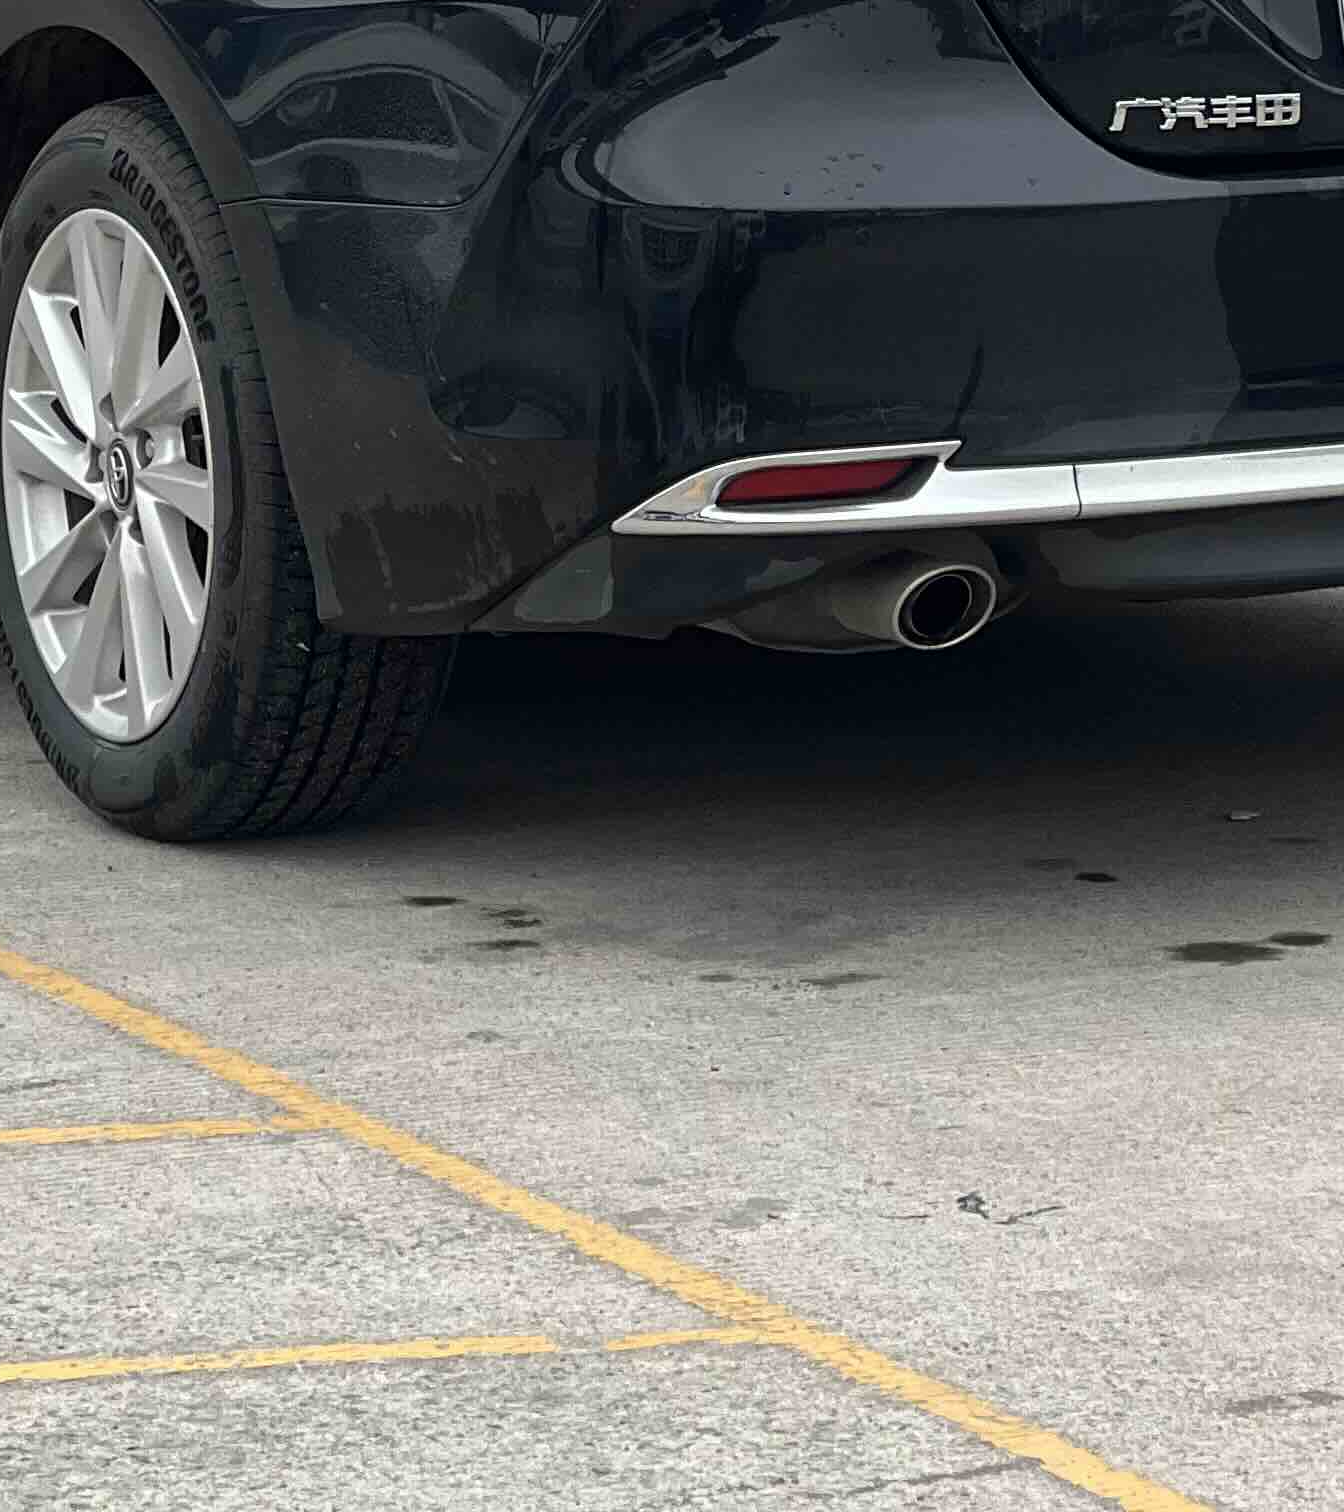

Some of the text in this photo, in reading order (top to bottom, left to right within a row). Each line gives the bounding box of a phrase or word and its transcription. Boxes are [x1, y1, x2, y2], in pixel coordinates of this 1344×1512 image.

[1109, 92, 1301, 132] 广汽丰田
[109, 148, 216, 343] BRIDGESTONE
